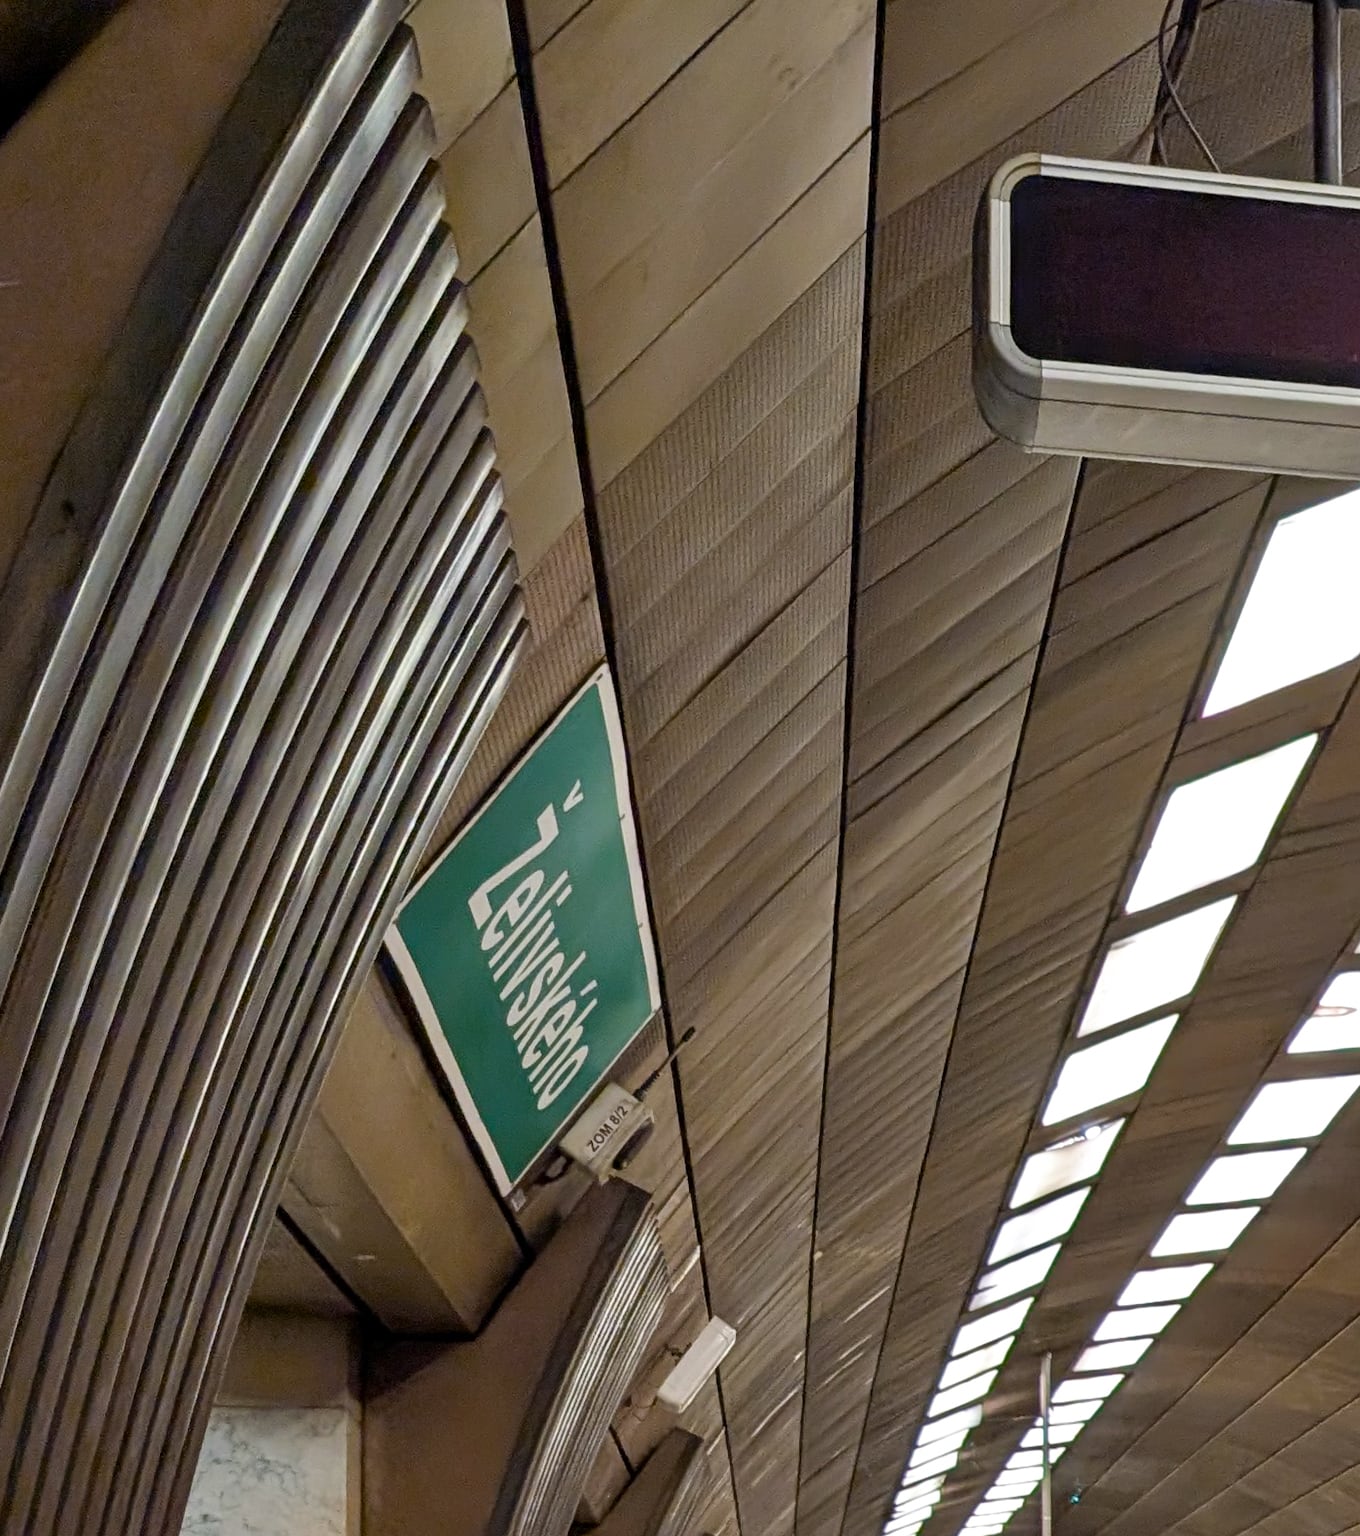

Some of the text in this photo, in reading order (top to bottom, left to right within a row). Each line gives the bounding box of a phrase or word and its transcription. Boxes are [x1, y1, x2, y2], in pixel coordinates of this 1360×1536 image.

[467, 778, 599, 1111] Želivského
[586, 1105, 629, 1153] ZOM 8/2
